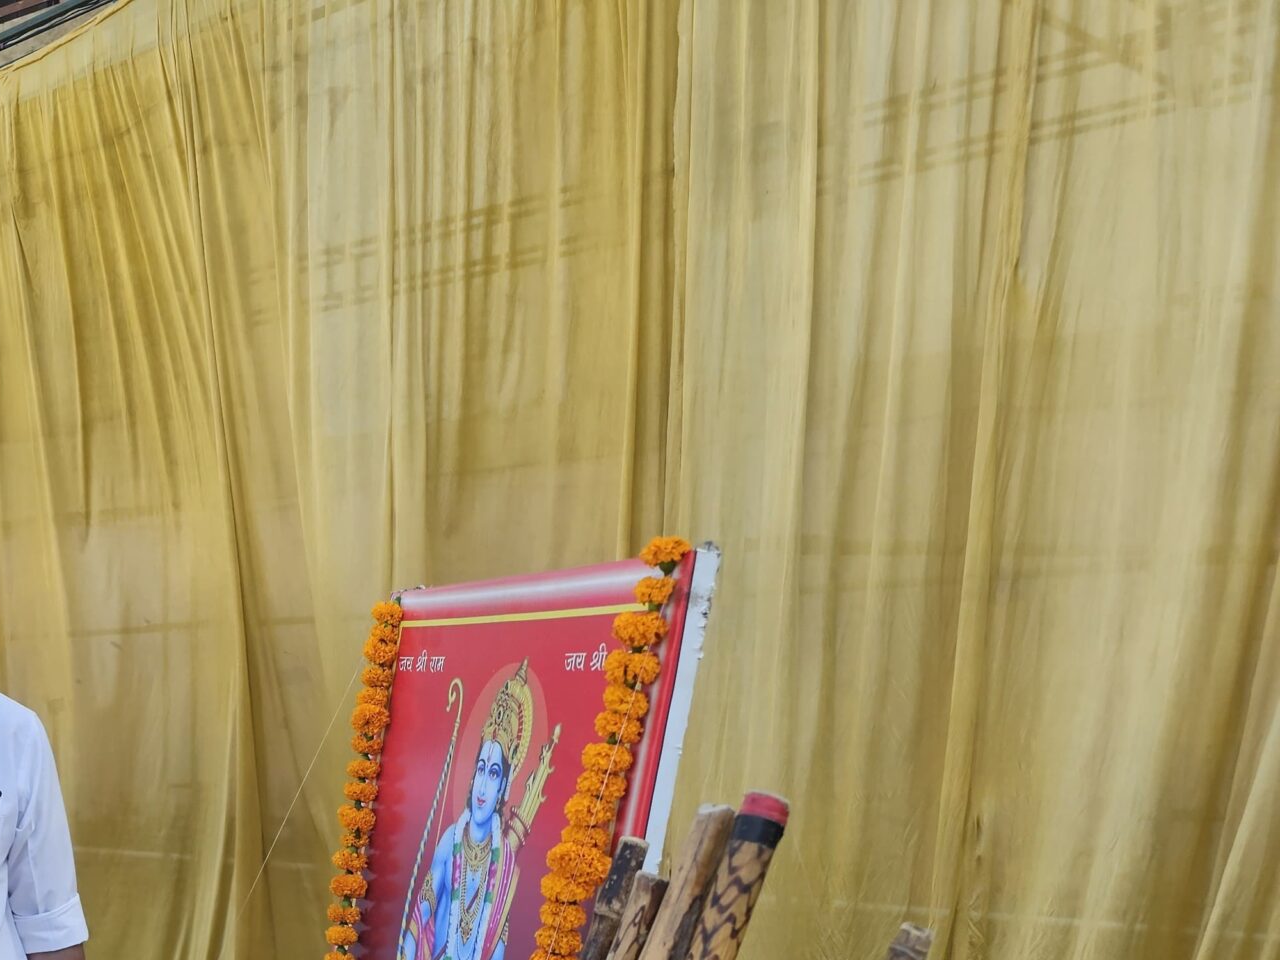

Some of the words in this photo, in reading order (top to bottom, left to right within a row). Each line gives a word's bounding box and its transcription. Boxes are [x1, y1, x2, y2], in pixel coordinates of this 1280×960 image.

[399, 656, 414, 672] जय
[416, 649, 428, 672] श्री
[430, 656, 446, 673] राम
[564, 652, 587, 671] जय
[590, 642, 608, 671] श्री
